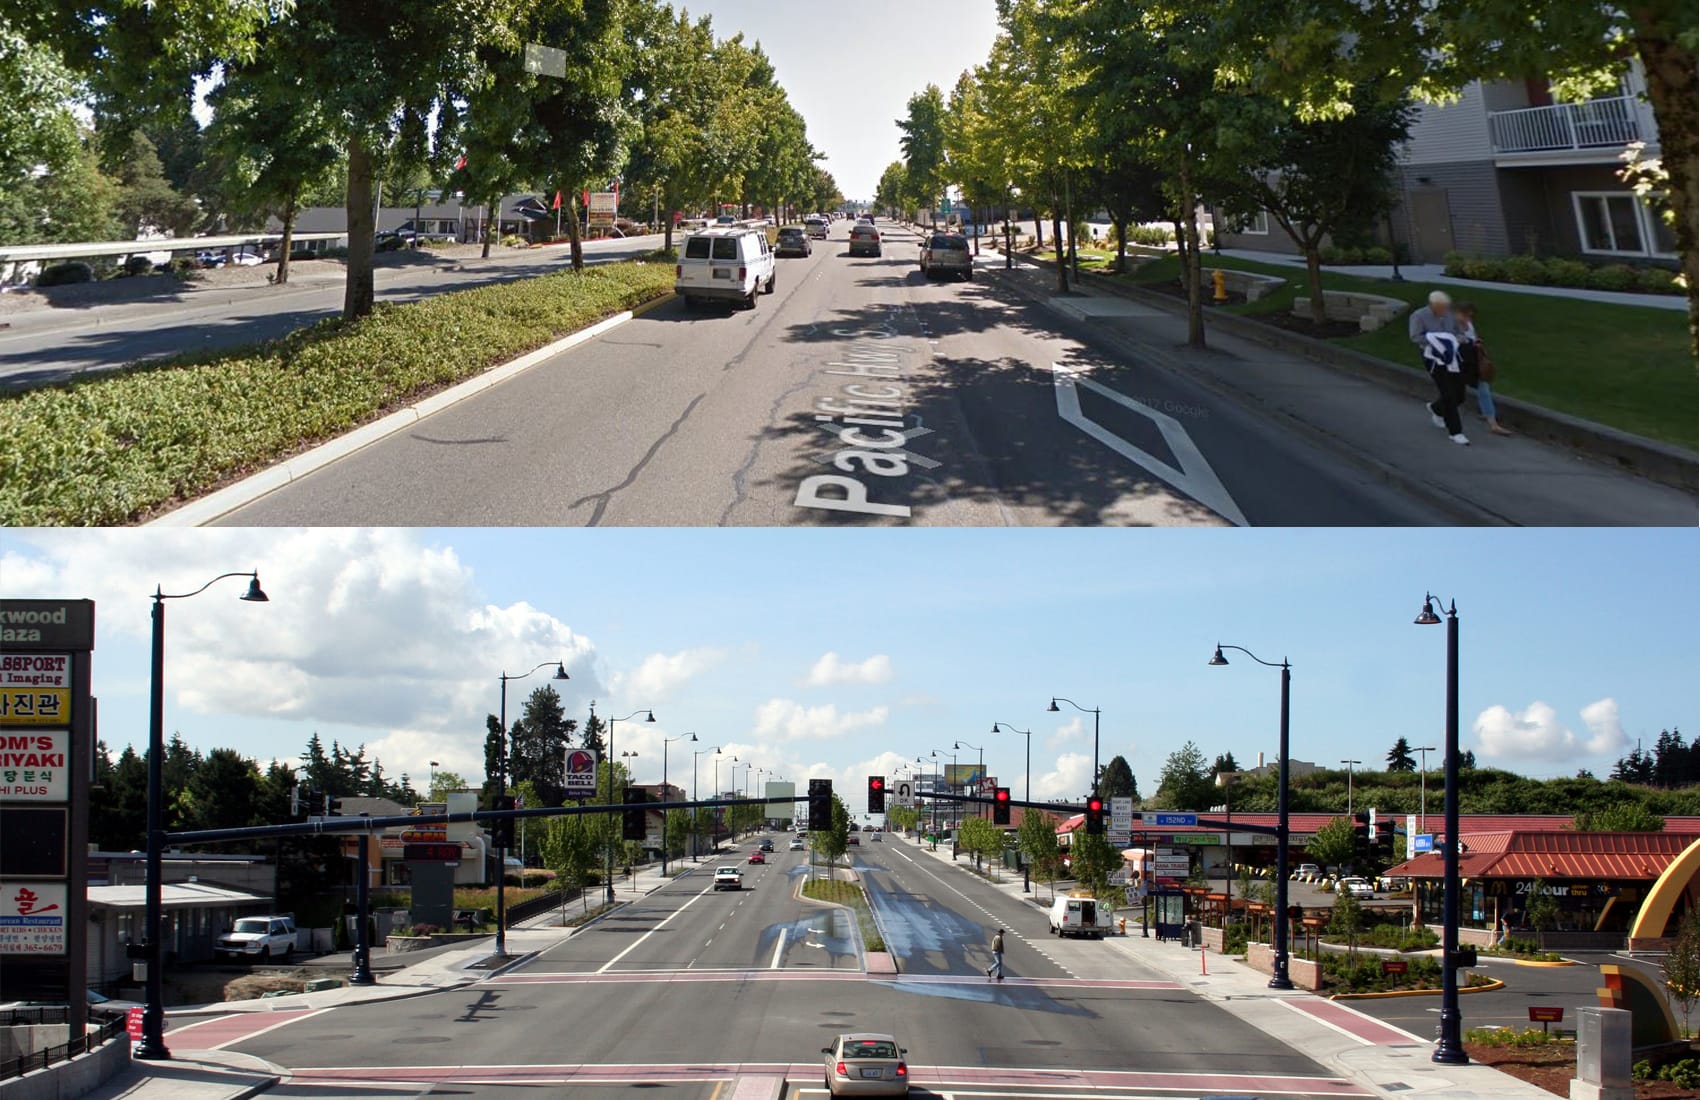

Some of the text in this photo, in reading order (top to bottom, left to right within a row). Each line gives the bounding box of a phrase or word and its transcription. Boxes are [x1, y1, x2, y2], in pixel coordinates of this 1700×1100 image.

[0, 657, 66, 672] SSPORT
[8, 673, 62, 686] Imaging
[15, 786, 48, 796] PLUS
